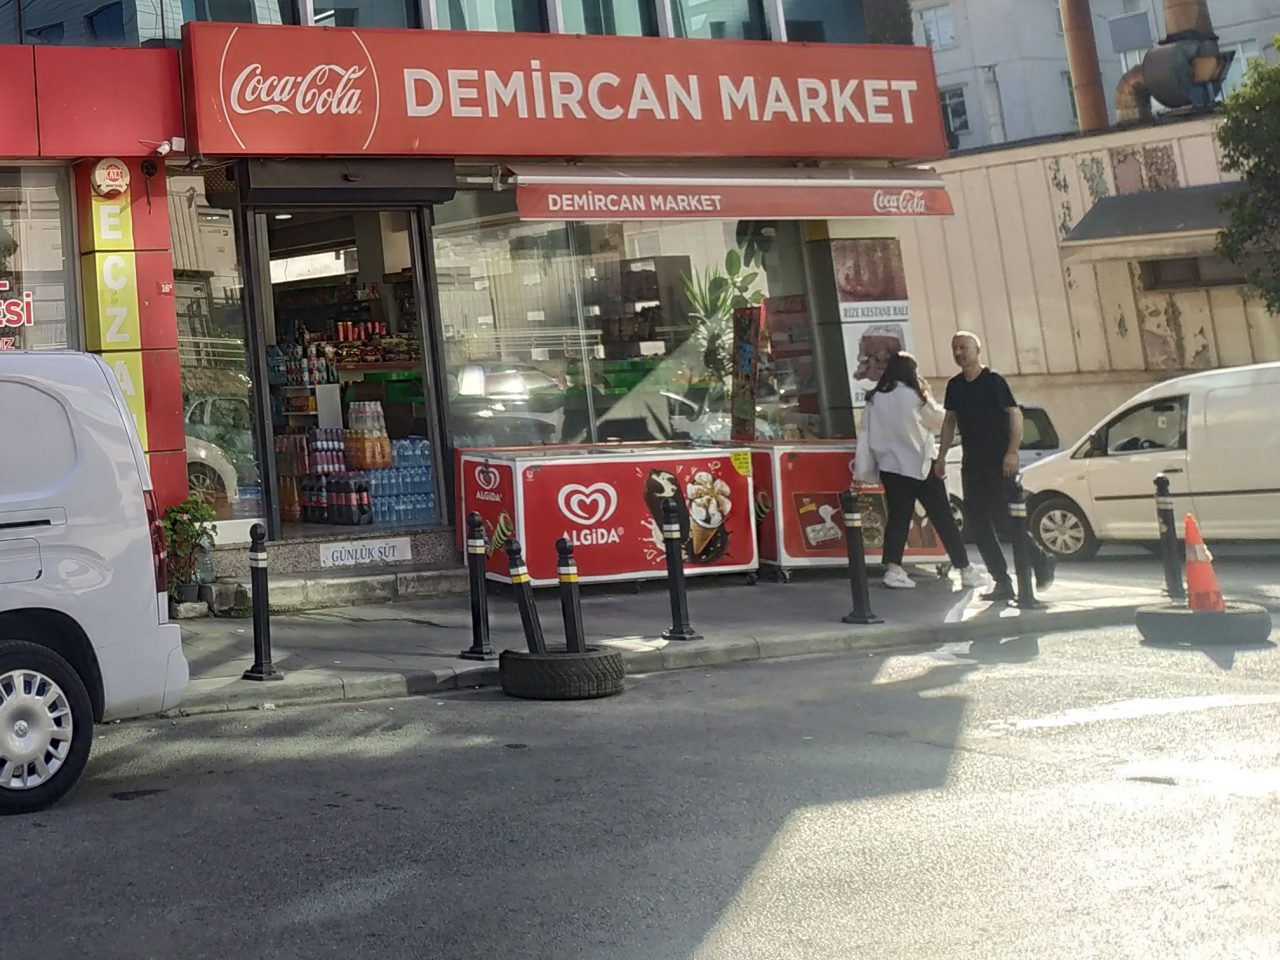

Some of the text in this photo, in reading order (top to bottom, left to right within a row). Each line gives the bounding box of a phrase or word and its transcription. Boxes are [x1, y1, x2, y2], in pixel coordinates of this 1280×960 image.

[230, 59, 919, 125] Coca-Cola DEMİRCAN MARKET
[548, 191, 645, 212] DEMİRCAN
[650, 194, 722, 211] MARKET
[331, 543, 398, 562] GÜNLÜK SÜT
